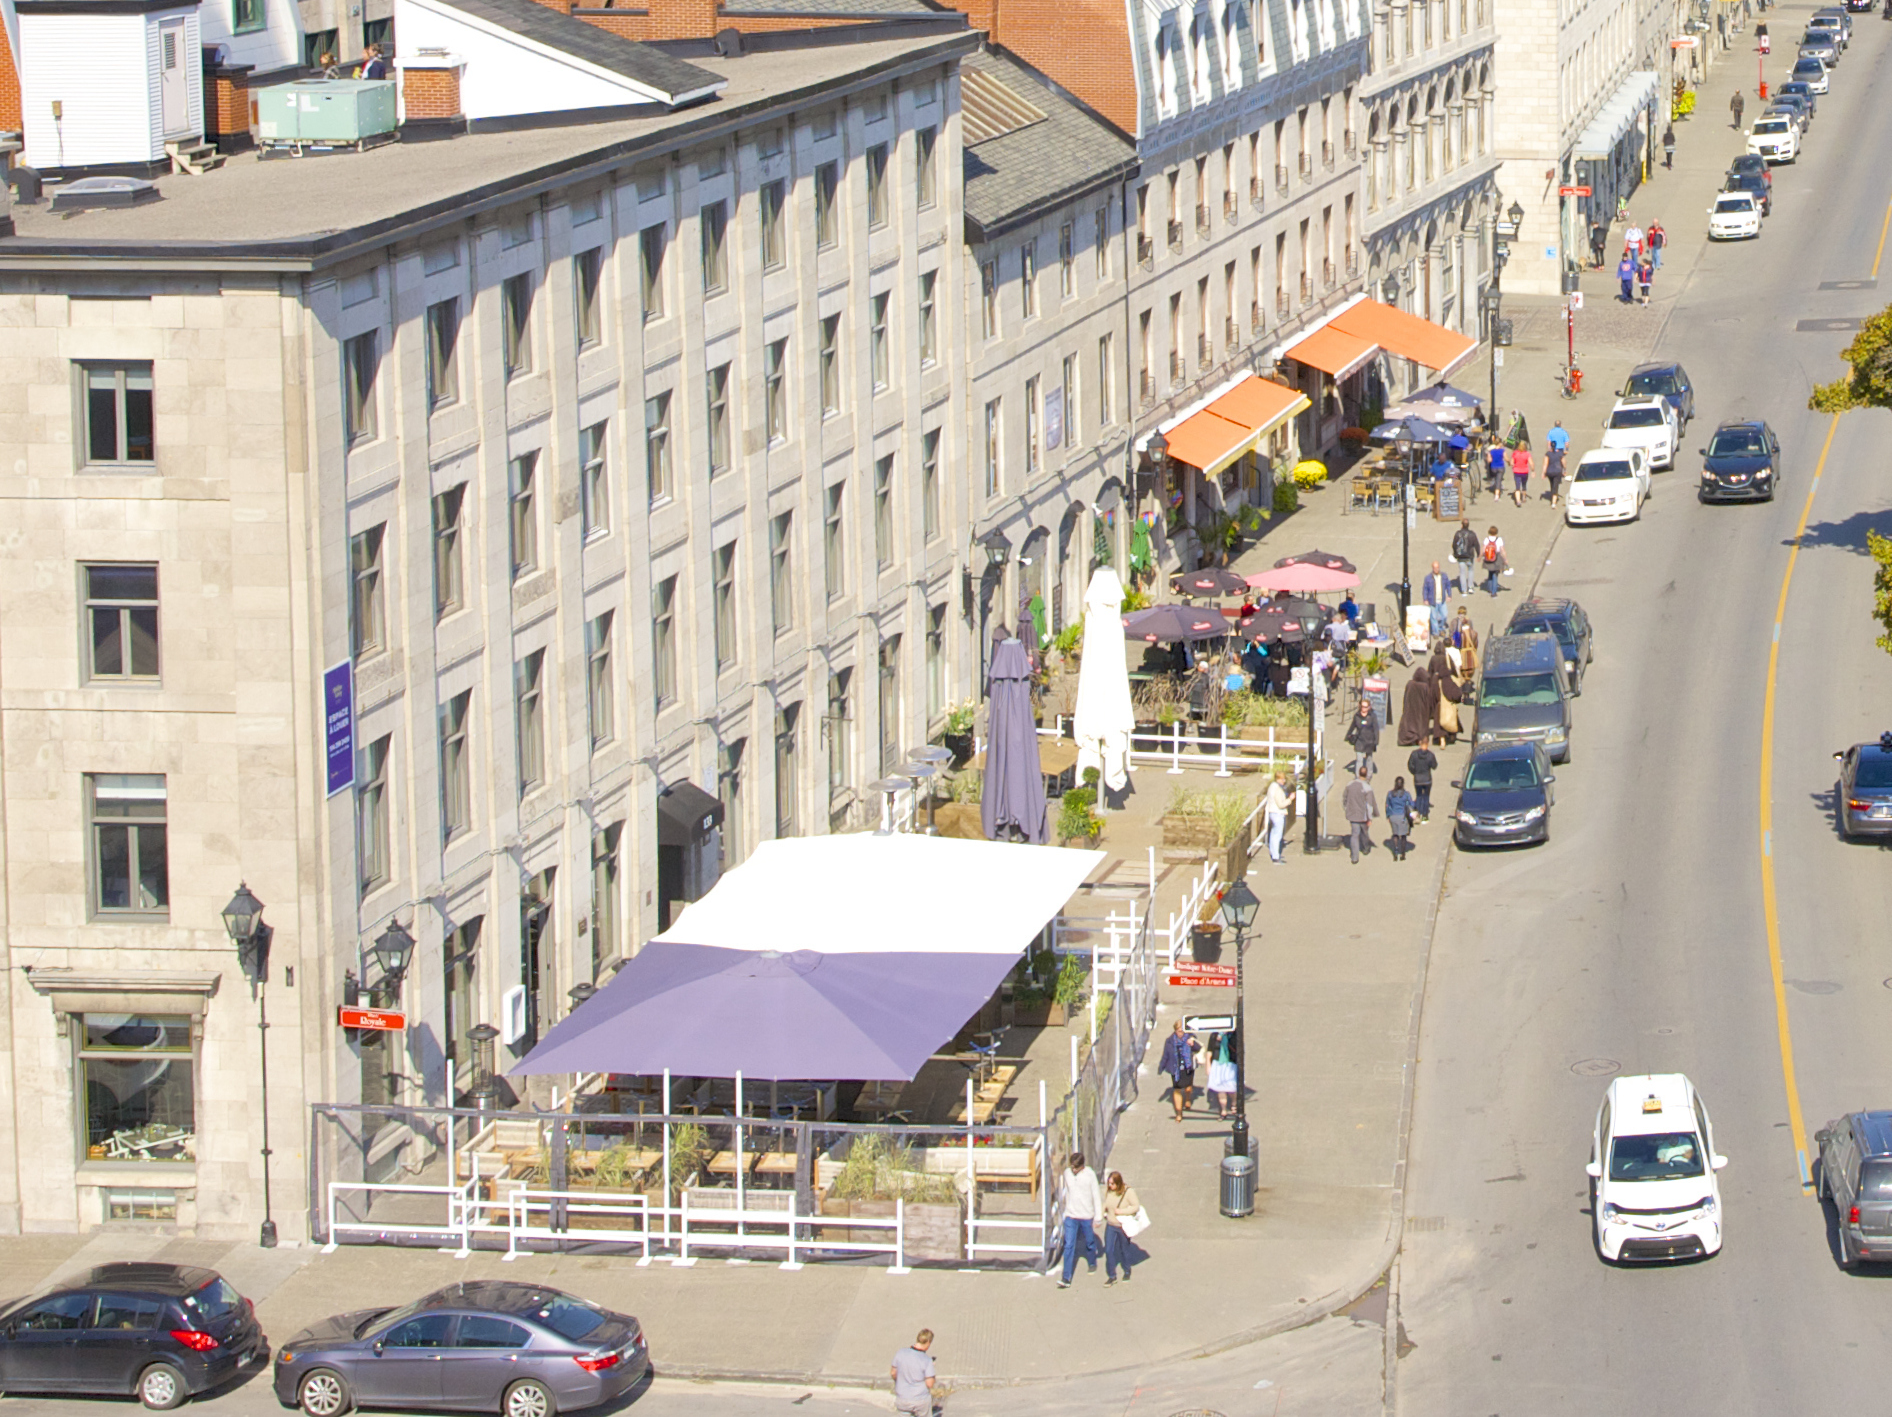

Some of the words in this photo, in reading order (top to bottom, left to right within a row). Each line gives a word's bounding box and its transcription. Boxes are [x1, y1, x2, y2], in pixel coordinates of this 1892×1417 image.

[328, 706, 350, 724] ESPACE
[333, 716, 350, 733] LOUER
[1180, 976, 1199, 985] Place
[360, 1016, 387, 1029] Royale
